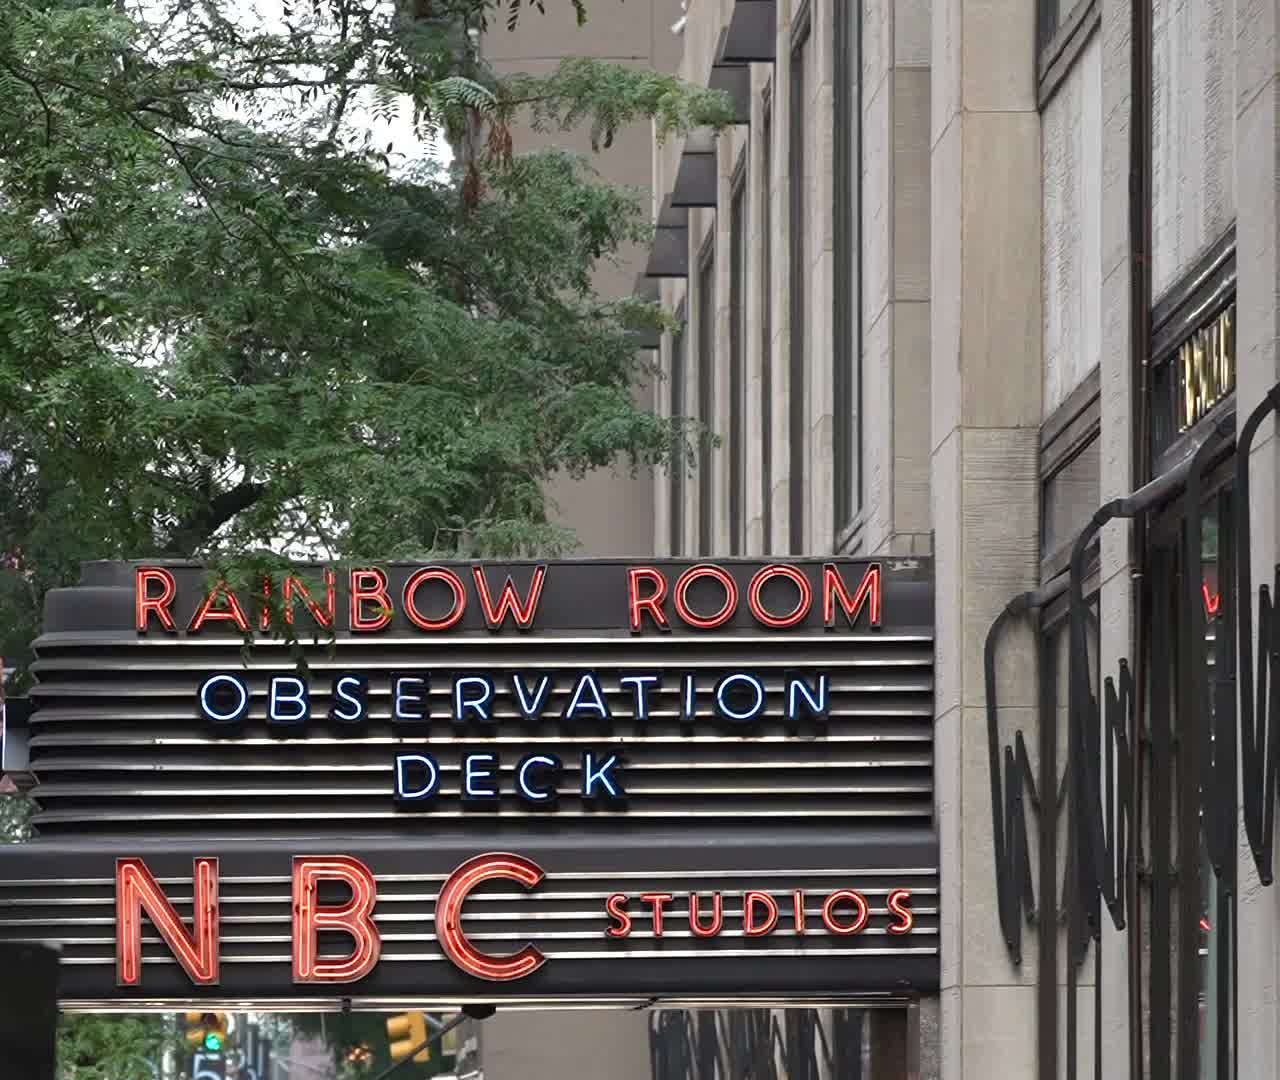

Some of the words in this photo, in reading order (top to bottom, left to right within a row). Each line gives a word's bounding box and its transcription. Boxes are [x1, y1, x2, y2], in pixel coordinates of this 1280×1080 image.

[135, 565, 547, 633] RAINBOW
[627, 562, 881, 633] ROOM
[200, 673, 827, 722] OBSERVATION
[395, 754, 621, 799] DECK
[116, 852, 548, 984] NBC
[604, 888, 914, 938] STUDIOS
